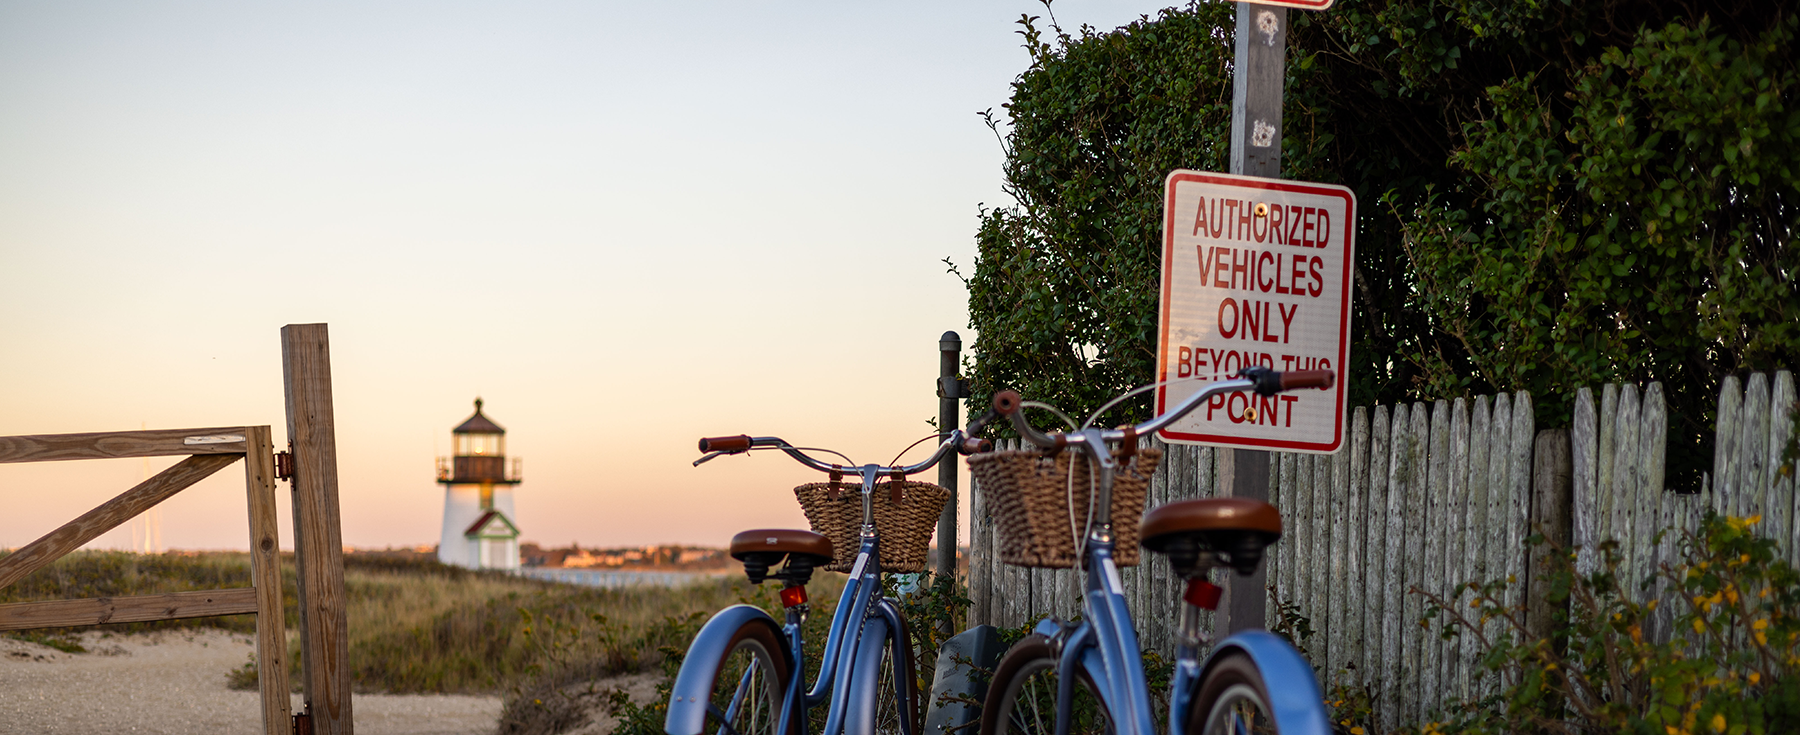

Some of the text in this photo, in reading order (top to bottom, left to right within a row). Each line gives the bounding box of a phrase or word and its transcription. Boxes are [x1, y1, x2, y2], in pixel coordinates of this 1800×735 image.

[1193, 196, 1331, 249] AUTHORIZED
[1197, 245, 1324, 298] VEHICLES
[1218, 298, 1299, 343] ONLY
[1206, 391, 1299, 428] POINT
